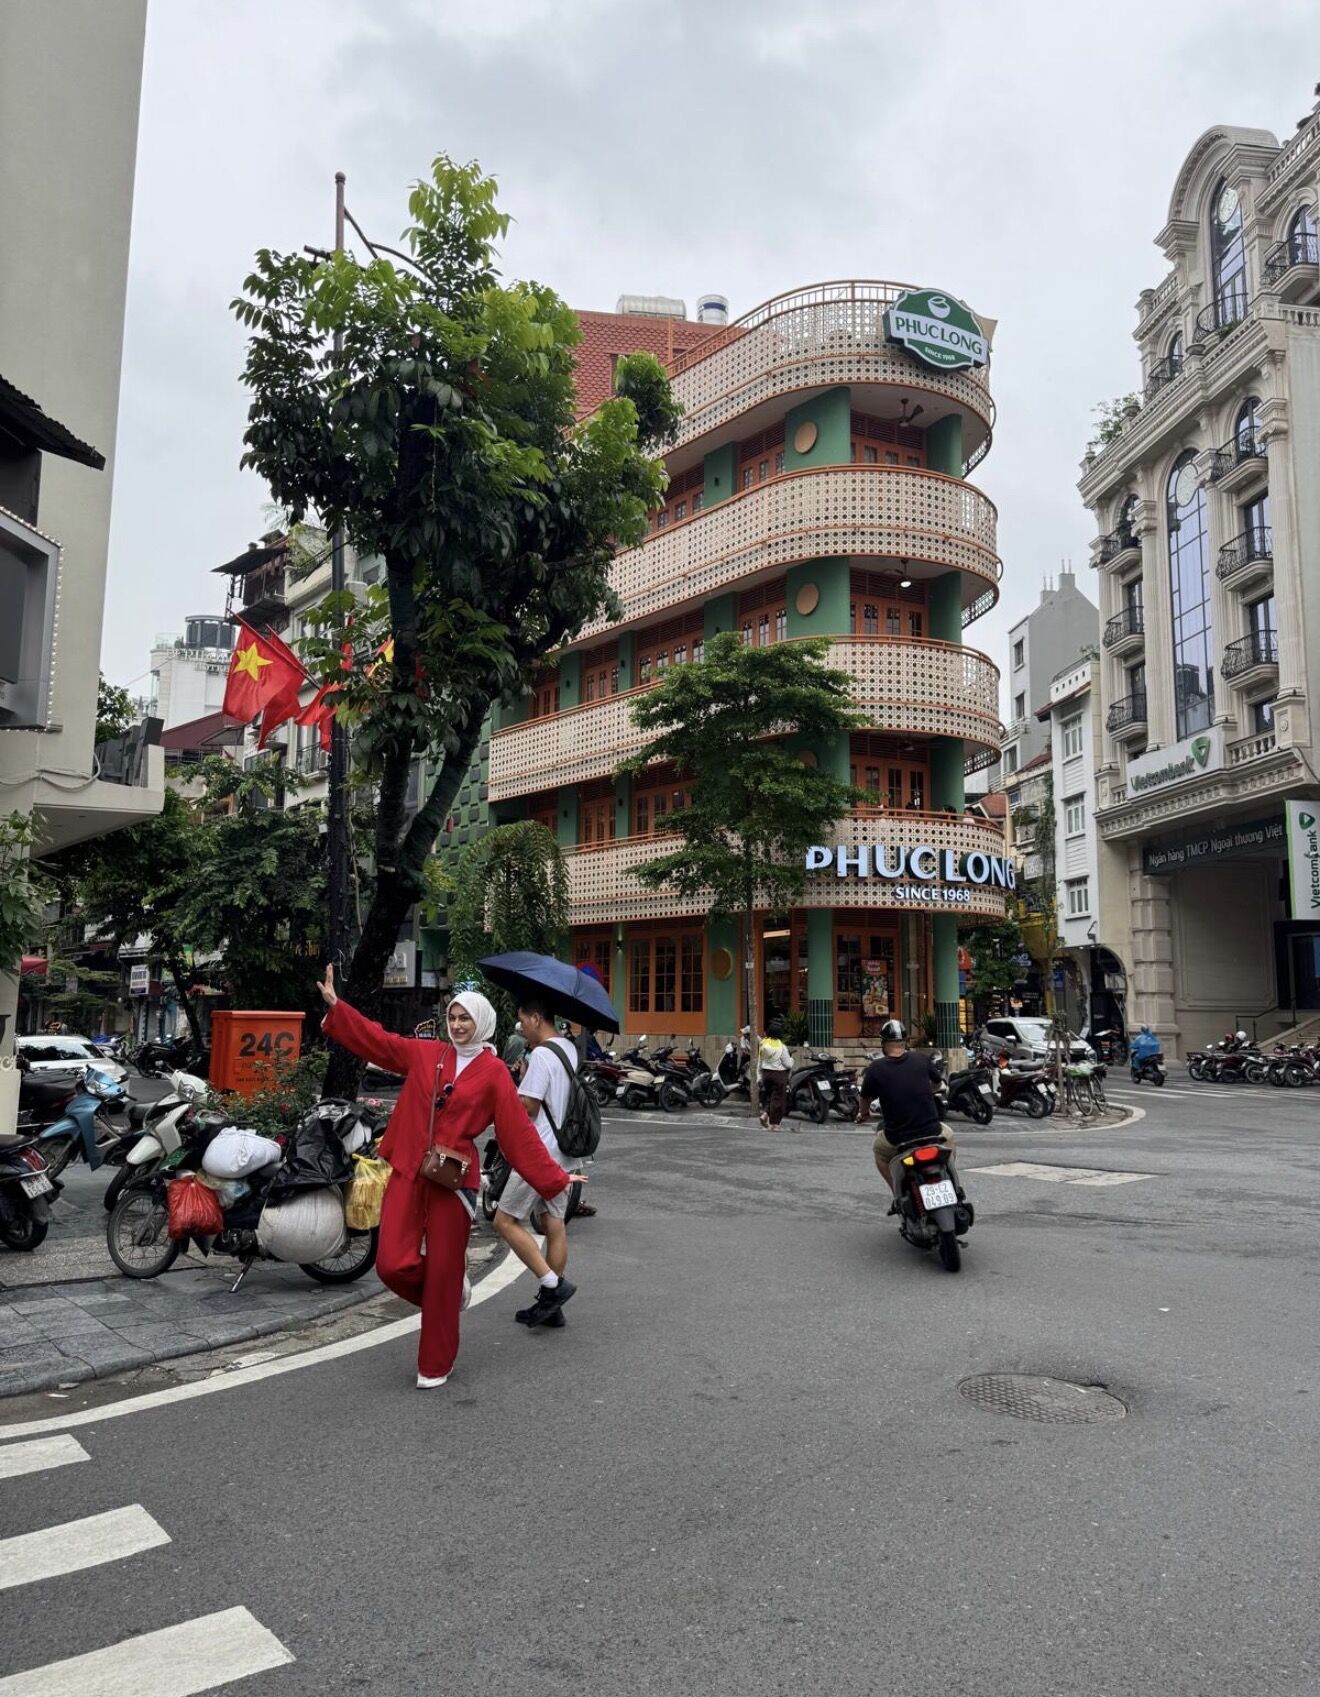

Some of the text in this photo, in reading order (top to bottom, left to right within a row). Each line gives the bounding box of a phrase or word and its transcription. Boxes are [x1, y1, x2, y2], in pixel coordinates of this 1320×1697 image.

[895, 316, 983, 355] PHUCLONG
[1186, 841, 1209, 858] TMCP
[895, 886, 971, 902] SINCE 1968
[239, 1031, 295, 1057] 24C
